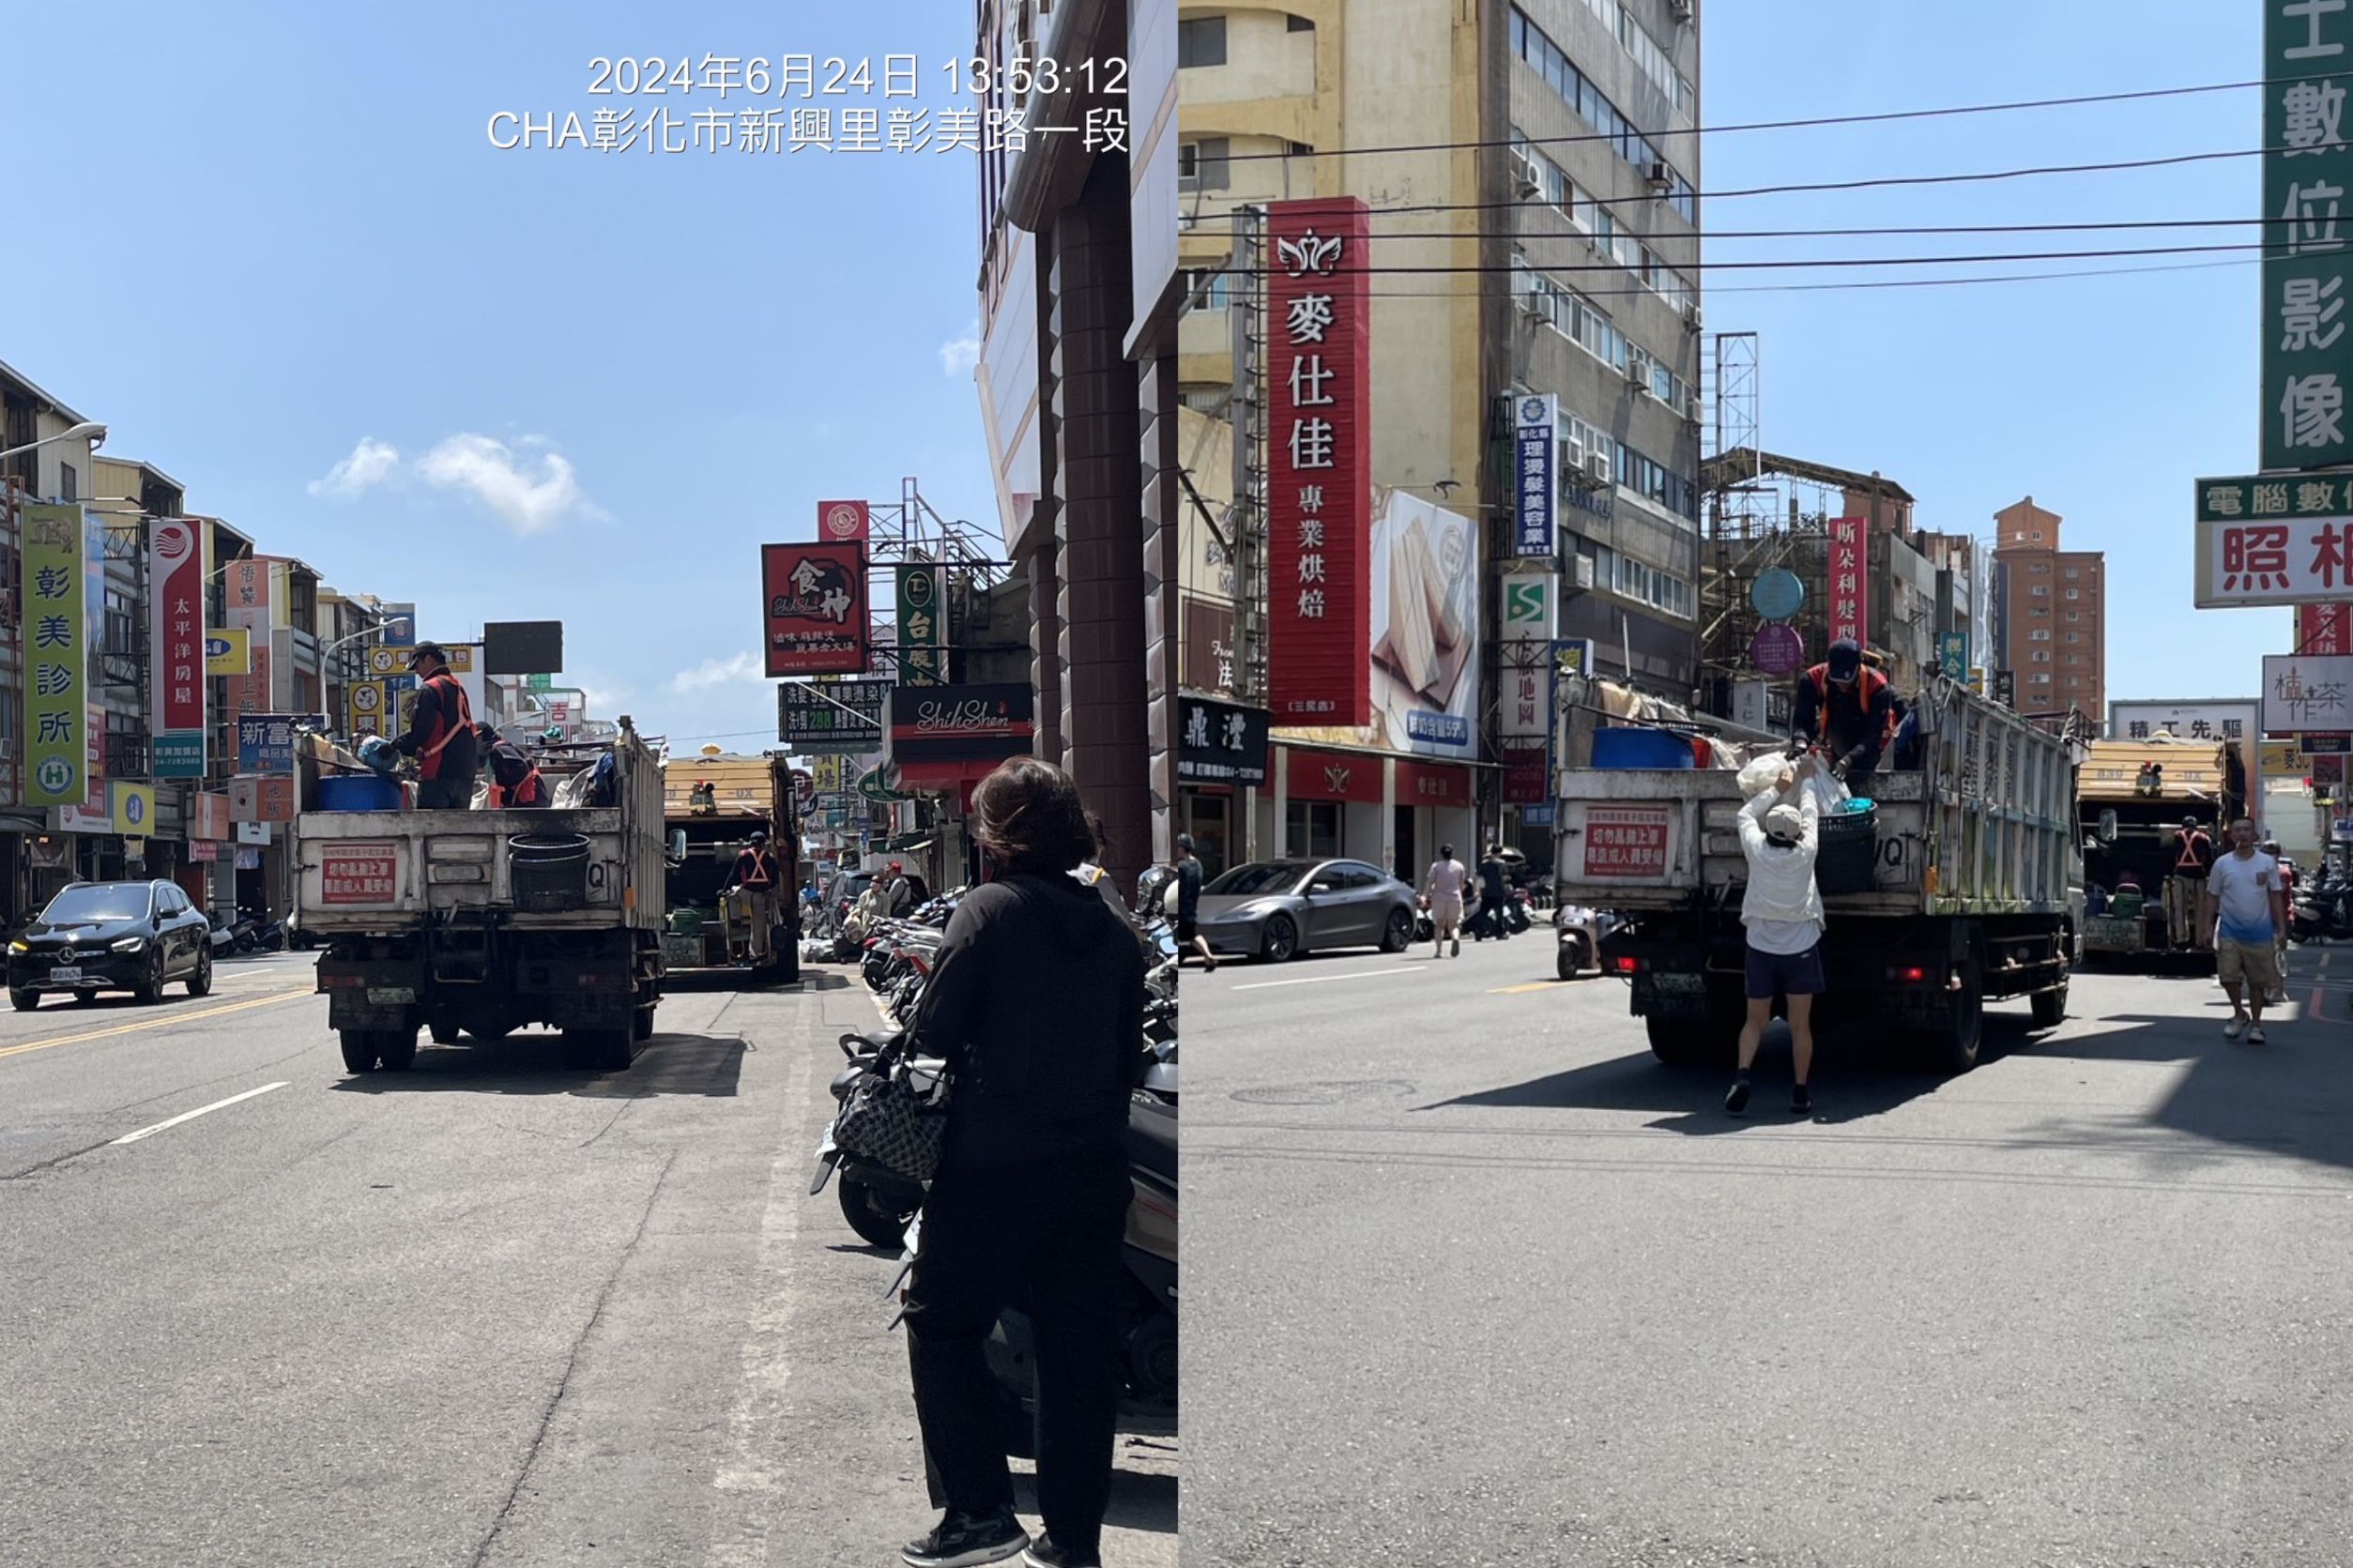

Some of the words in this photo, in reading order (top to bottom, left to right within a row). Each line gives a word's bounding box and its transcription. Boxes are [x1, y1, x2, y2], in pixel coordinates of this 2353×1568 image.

[1286, 291, 1334, 472] 麥仕佳
[1523, 441, 1546, 544] 理燙髮美容業
[2207, 480, 2353, 515] 電腦數
[790, 559, 851, 623] 食神
[1297, 485, 1325, 619] 專業烘焙
[35, 565, 72, 744] 彰美診所
[174, 598, 192, 704] 太平洋房屋
[916, 700, 1009, 732] ShihShen
[2130, 719, 2243, 738] 精工先驅
